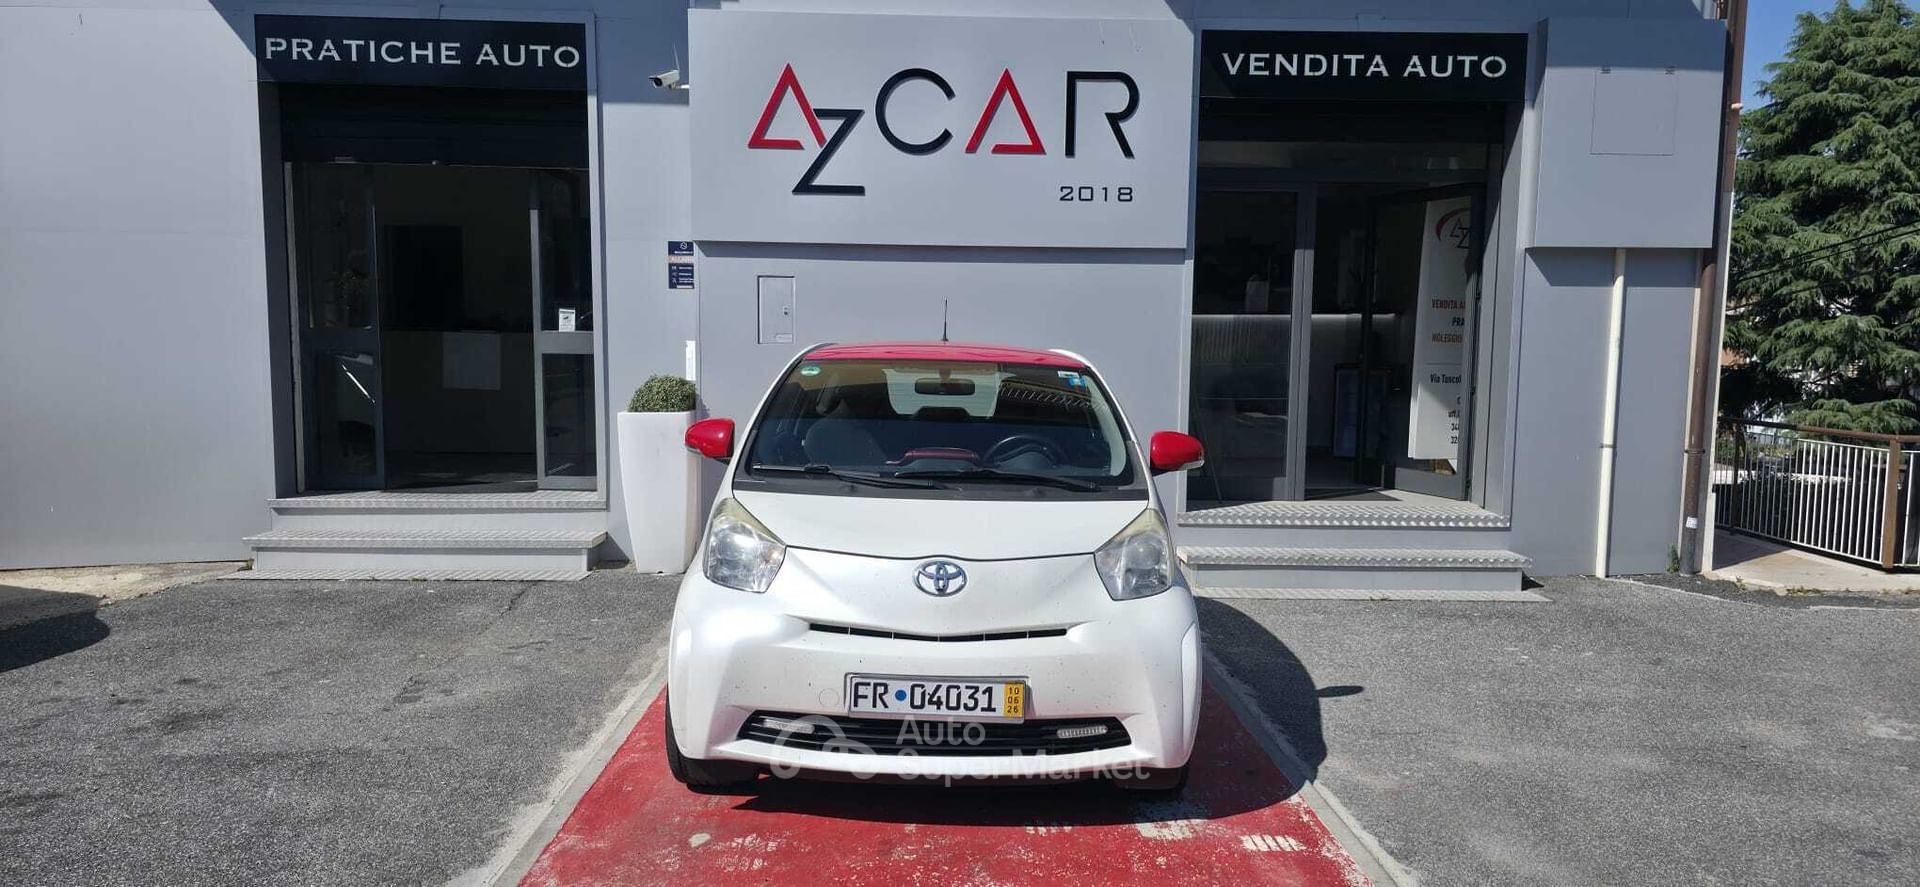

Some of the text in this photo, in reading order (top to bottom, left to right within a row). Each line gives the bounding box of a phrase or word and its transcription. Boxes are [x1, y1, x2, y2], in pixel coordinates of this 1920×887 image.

[265, 37, 580, 68] PRATICHE AUTO
[1222, 52, 1507, 78] VENDITA AUTO
[1060, 186, 1133, 202] 2018
[1431, 298, 1457, 309] VENDITA
[1430, 374, 1440, 383] Via
[853, 682, 997, 713] FR 04031
